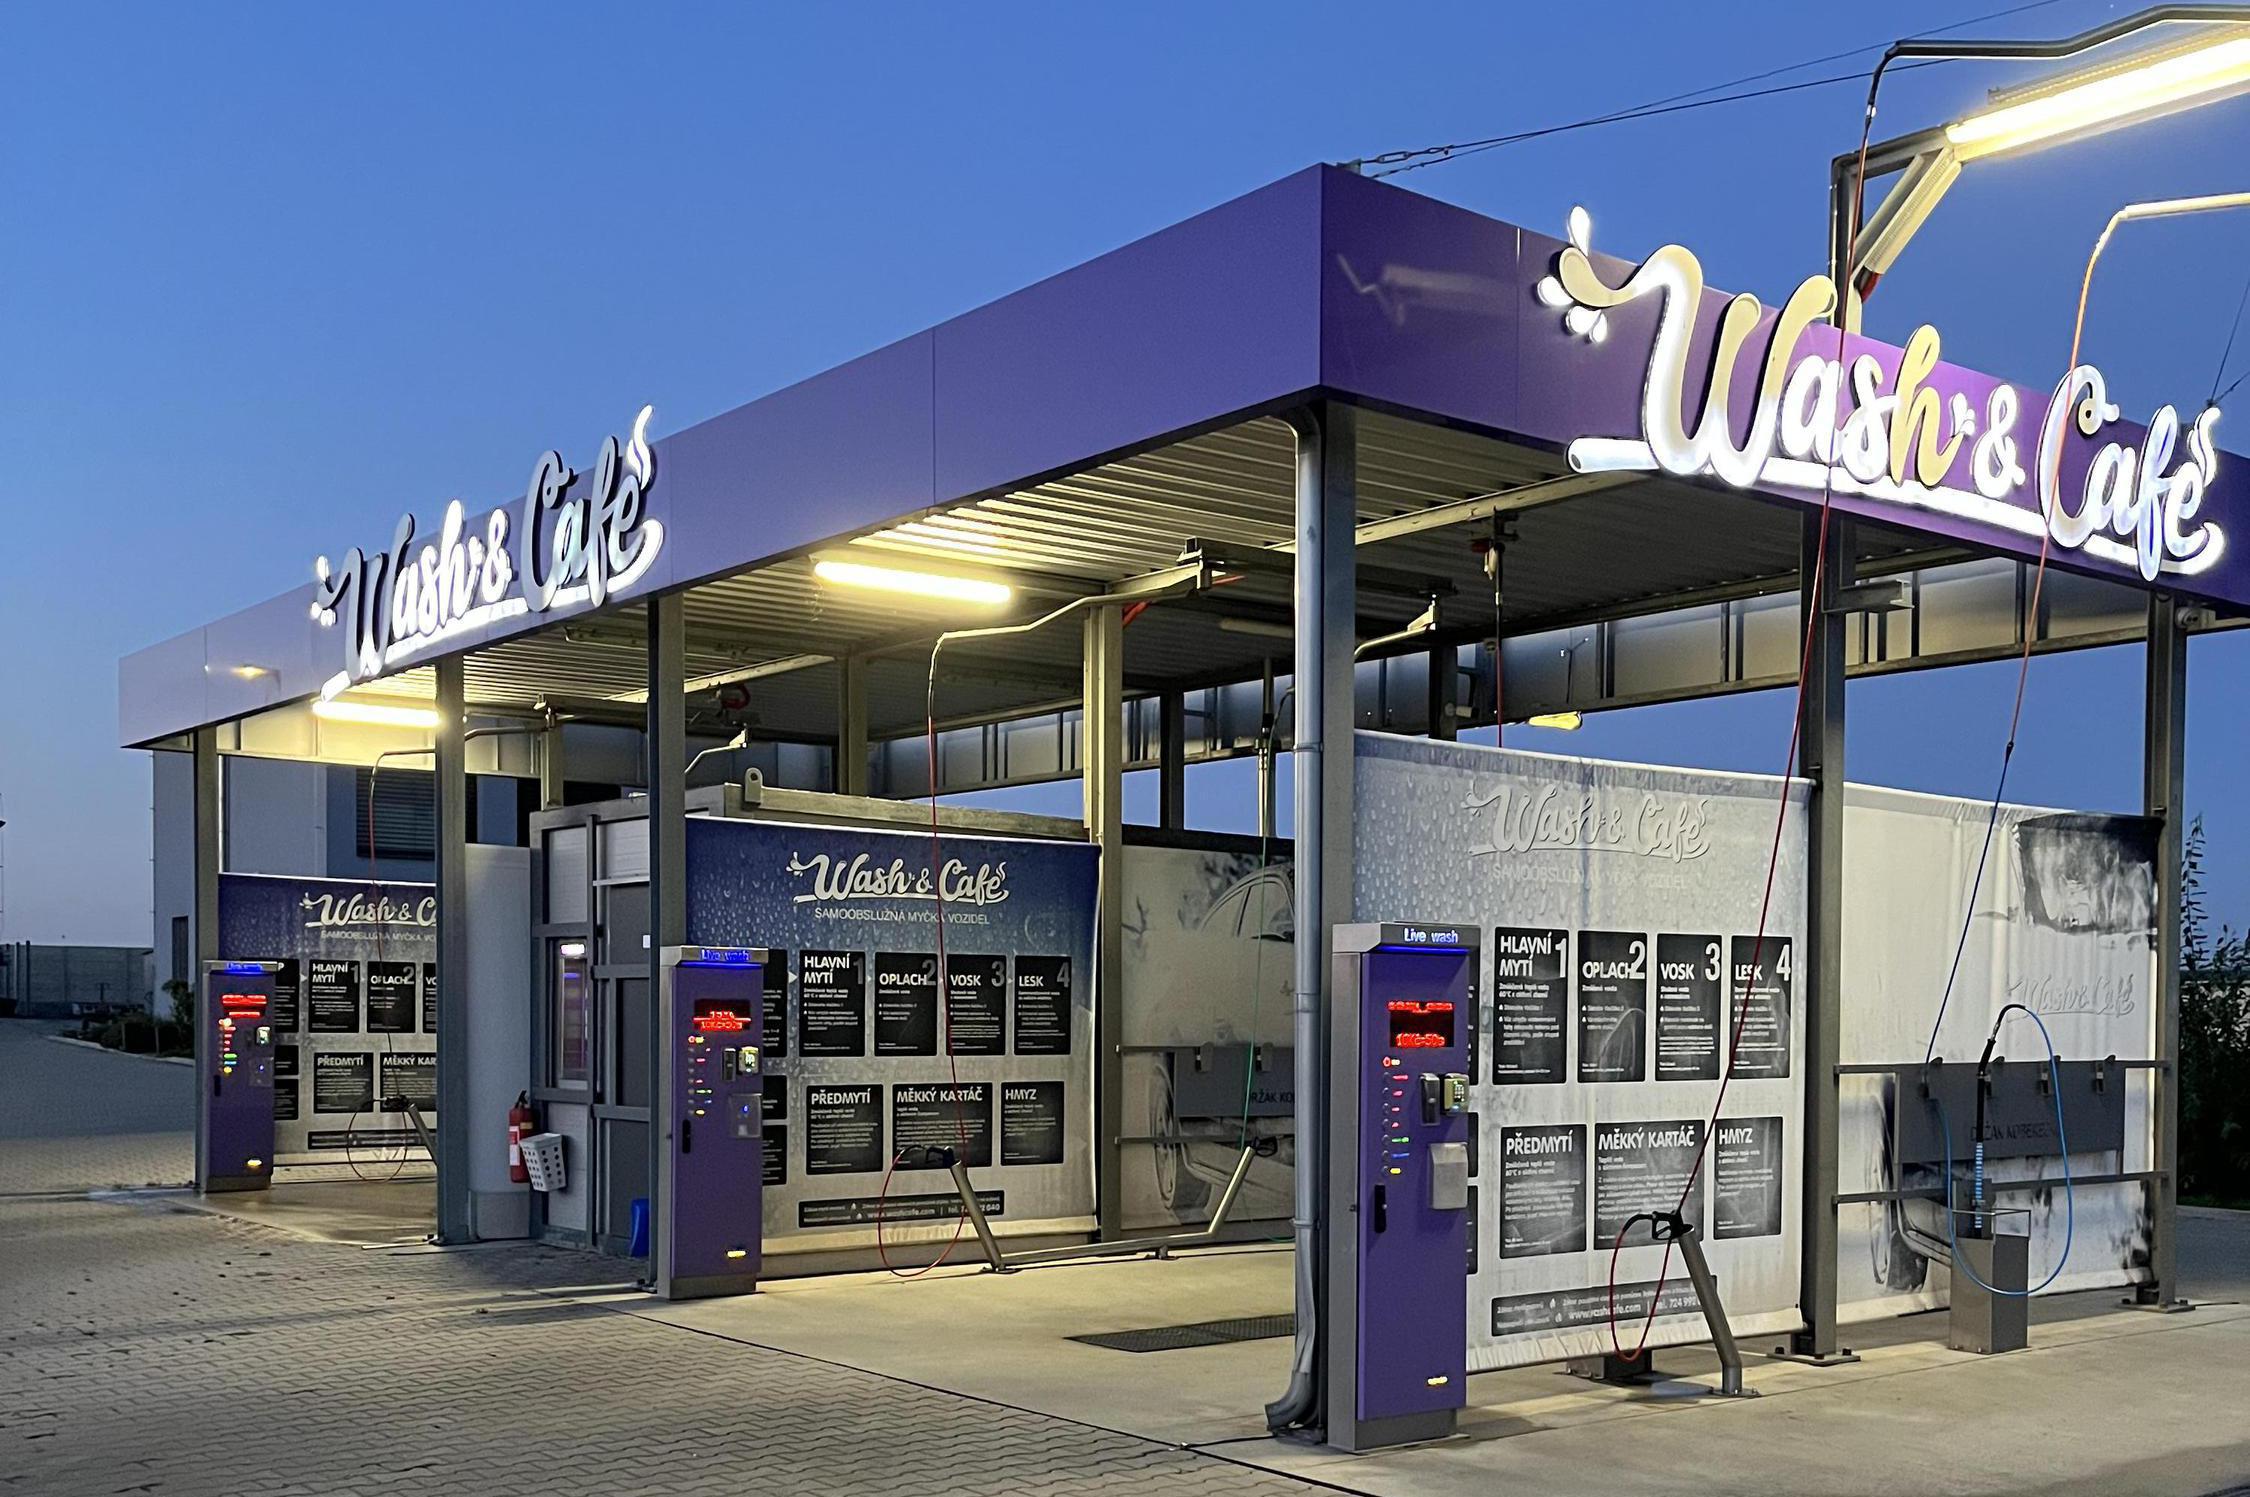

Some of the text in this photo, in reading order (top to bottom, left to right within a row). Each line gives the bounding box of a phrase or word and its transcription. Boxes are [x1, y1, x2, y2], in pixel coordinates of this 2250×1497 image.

[1560, 244, 2224, 582] Wash & Café
[316, 500, 482, 682] Wash
[482, 508, 512, 603] &
[1465, 785, 1601, 853] Wash
[1608, 807, 1626, 844] &
[790, 853, 912, 900] Wash
[915, 867, 933, 893] &
[303, 893, 396, 926] Wash
[398, 903, 412, 920] &
[947, 913, 990, 925] VOZIDEL
[1404, 927, 1459, 943] Live wash
[1500, 932, 1552, 955] HLAVNÍ
[312, 962, 349, 973] HLAVNÍ
[804, 952, 851, 969] HLAVNÍ
[1499, 955, 1533, 977] MYTÍ
[1555, 937, 1567, 978] 1
[1629, 940, 1646, 979] 2
[1705, 943, 1721, 981] 3
[1776, 944, 1791, 981] 4
[403, 966, 415, 985] 2
[803, 968, 834, 984] MYTÍ
[853, 958, 864, 985] 1
[879, 973, 927, 986] OPLACH
[921, 959, 937, 986] 2
[950, 974, 982, 986] VOSK
[991, 960, 1005, 987] 3
[1019, 975, 1044, 987] LESK
[1056, 962, 1071, 988] 4
[1582, 961, 1634, 979] OPLACH
[1660, 963, 1695, 980] VOSK
[1735, 964, 1763, 981] LESK
[810, 1088, 871, 1105] PŘEDMYTÍ
[896, 1086, 983, 1103] MĚKKÝ KARTÁČ
[1005, 1089, 1037, 1101] HMYZ
[1506, 1129, 1573, 1155] PŘEDMYTÍ
[1598, 1125, 1695, 1150] MĚKKÝ KARTÁČ
[1719, 1128, 1753, 1145] HMYZ
